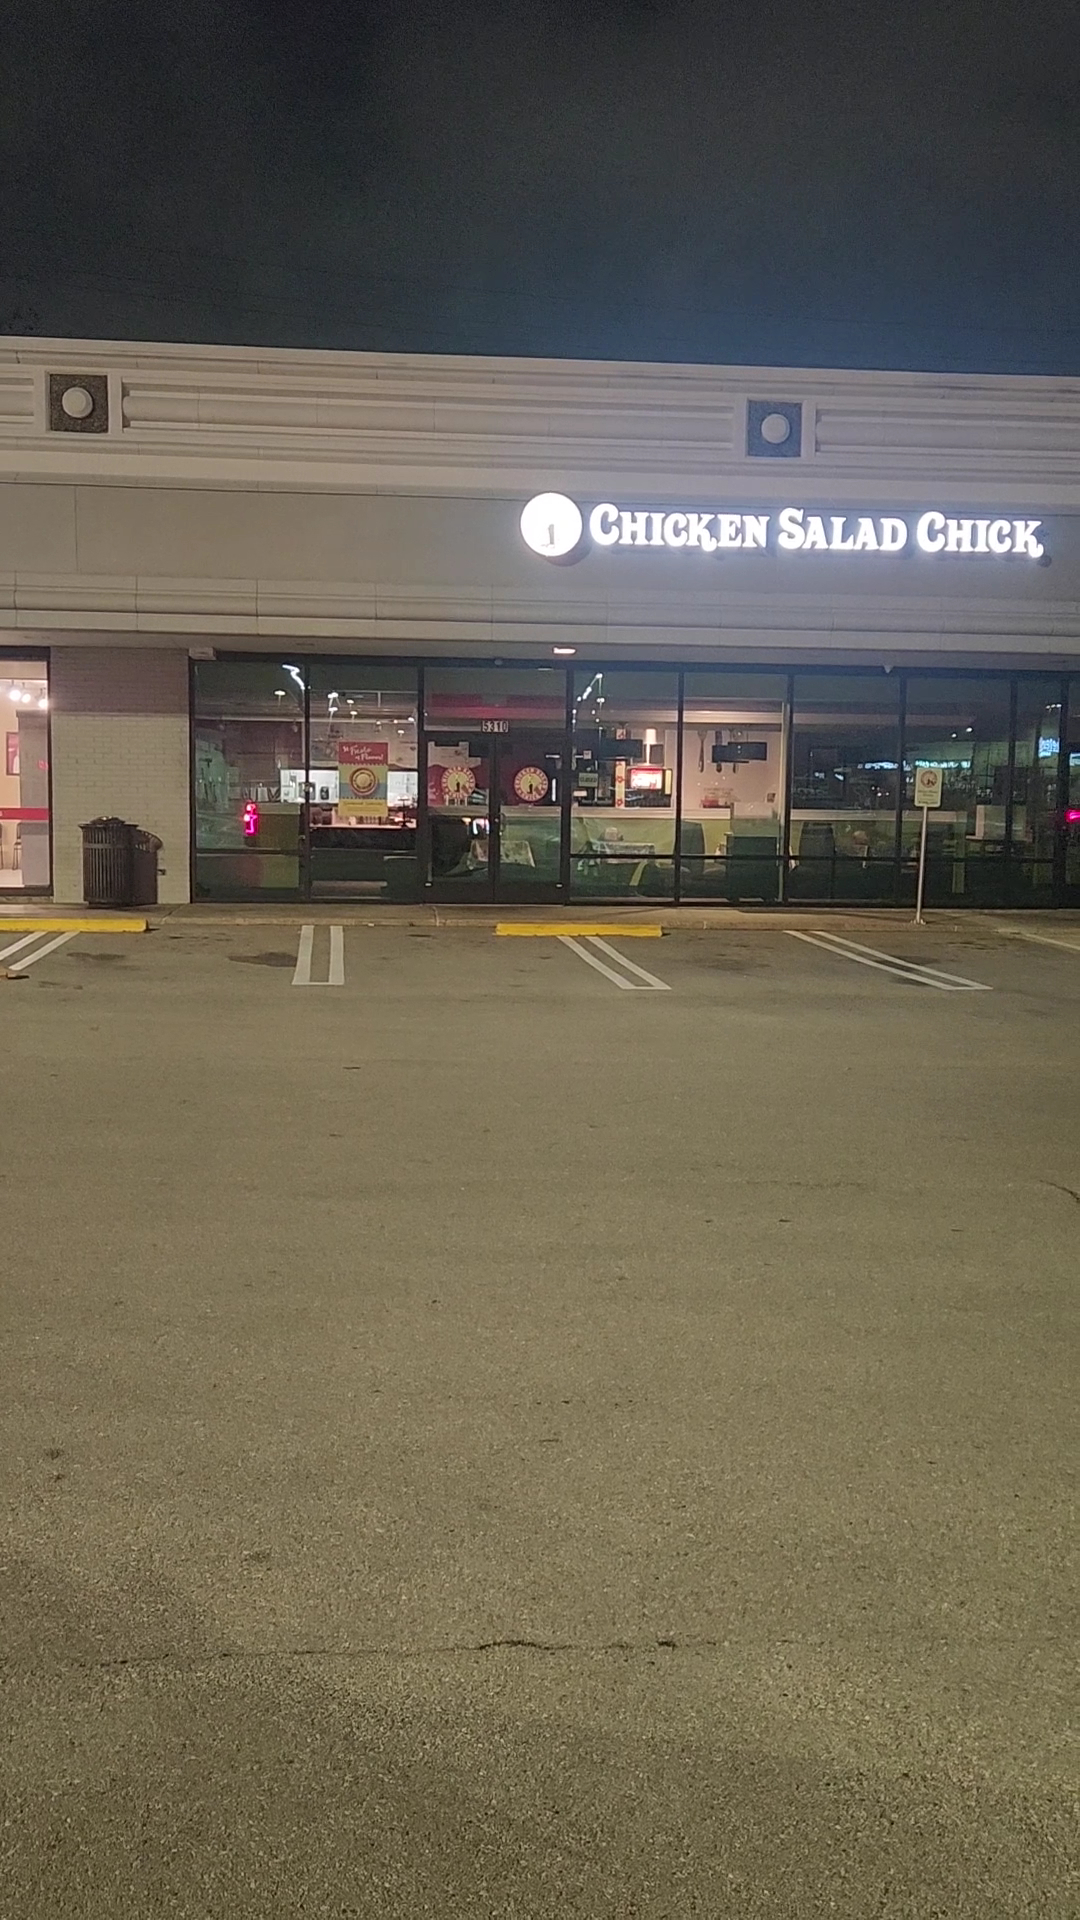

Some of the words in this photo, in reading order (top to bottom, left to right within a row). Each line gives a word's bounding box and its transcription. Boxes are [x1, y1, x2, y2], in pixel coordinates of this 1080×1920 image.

[589, 503, 770, 552] CHICKEN
[777, 507, 908, 550] SALAD
[916, 511, 1044, 558] CHICK
[483, 721, 508, 732] 5310
